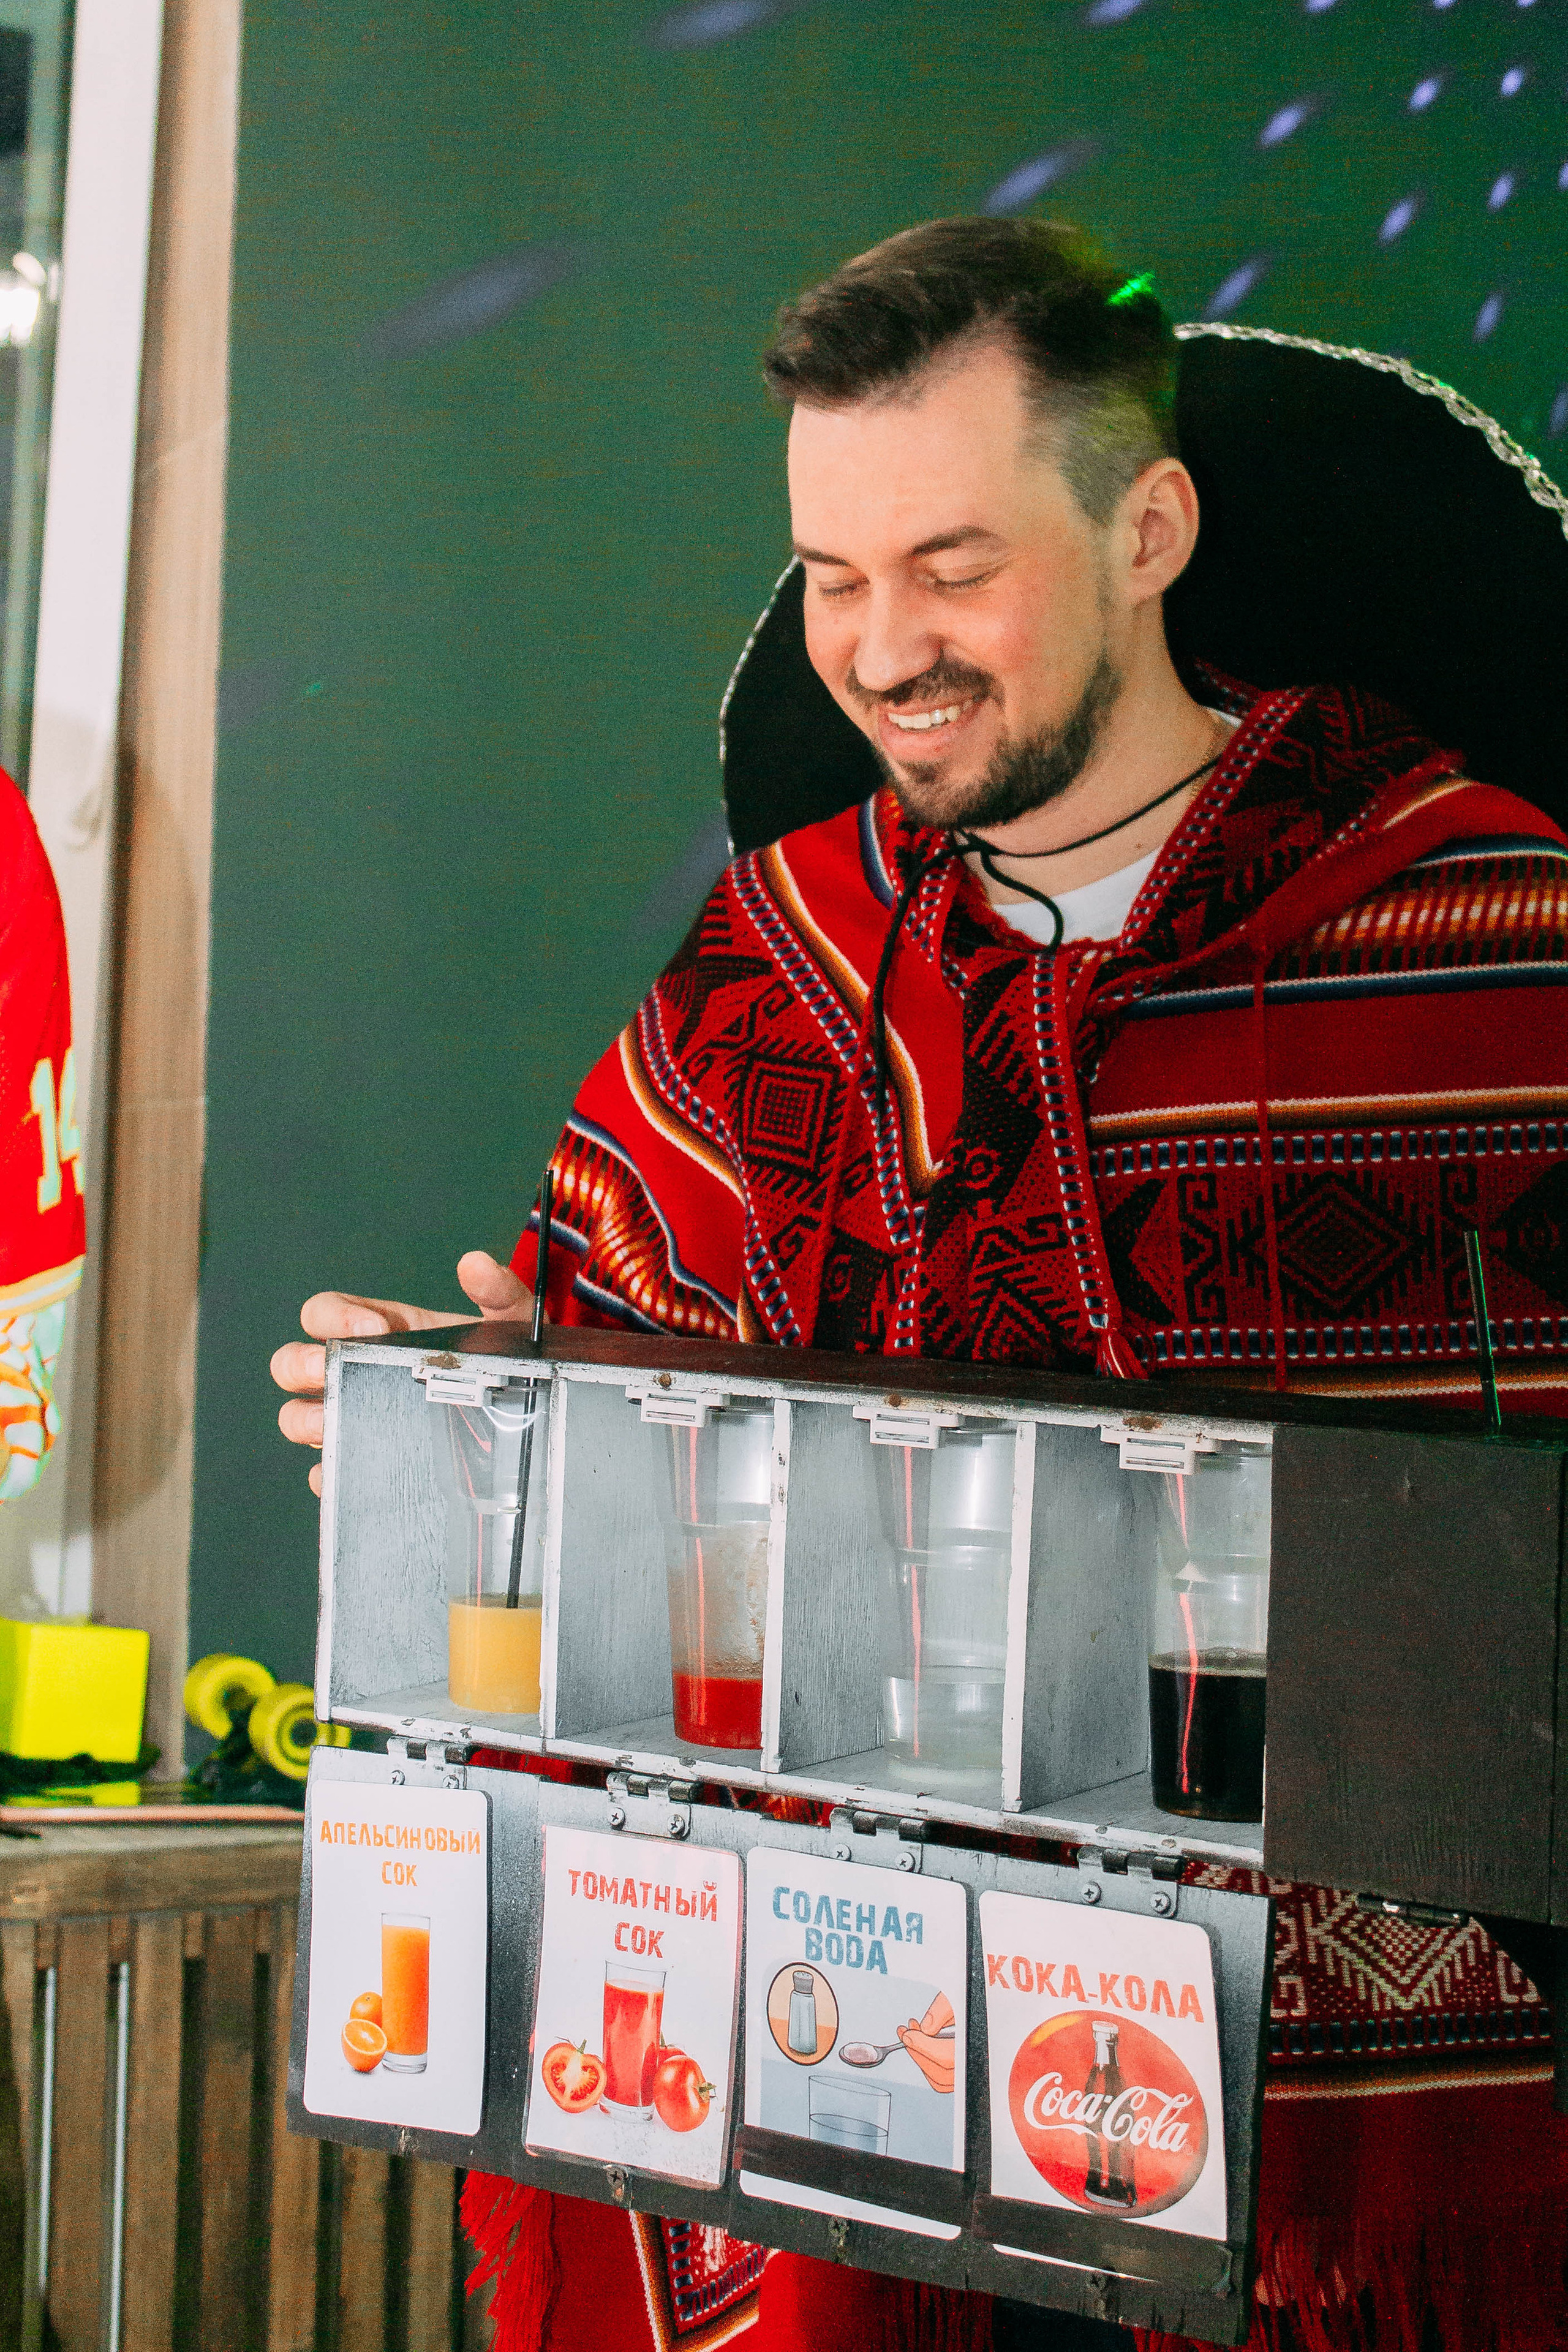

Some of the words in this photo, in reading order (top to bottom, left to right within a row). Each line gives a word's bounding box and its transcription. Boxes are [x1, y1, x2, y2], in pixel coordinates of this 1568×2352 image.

[320, 1819, 481, 1855] АПЕЛЬСИНОВЫЙ
[381, 1860, 418, 1887] СОК
[567, 1868, 718, 1923] ТОМАТНЫЙ
[614, 1921, 665, 1959] СОК
[772, 1886, 924, 1945] СОЛЕНАЯ
[804, 1927, 888, 1975] ВОДА
[987, 1953, 1205, 2023] КОКА-КОЛА
[1023, 2071, 1194, 2152] Coca-Cola
